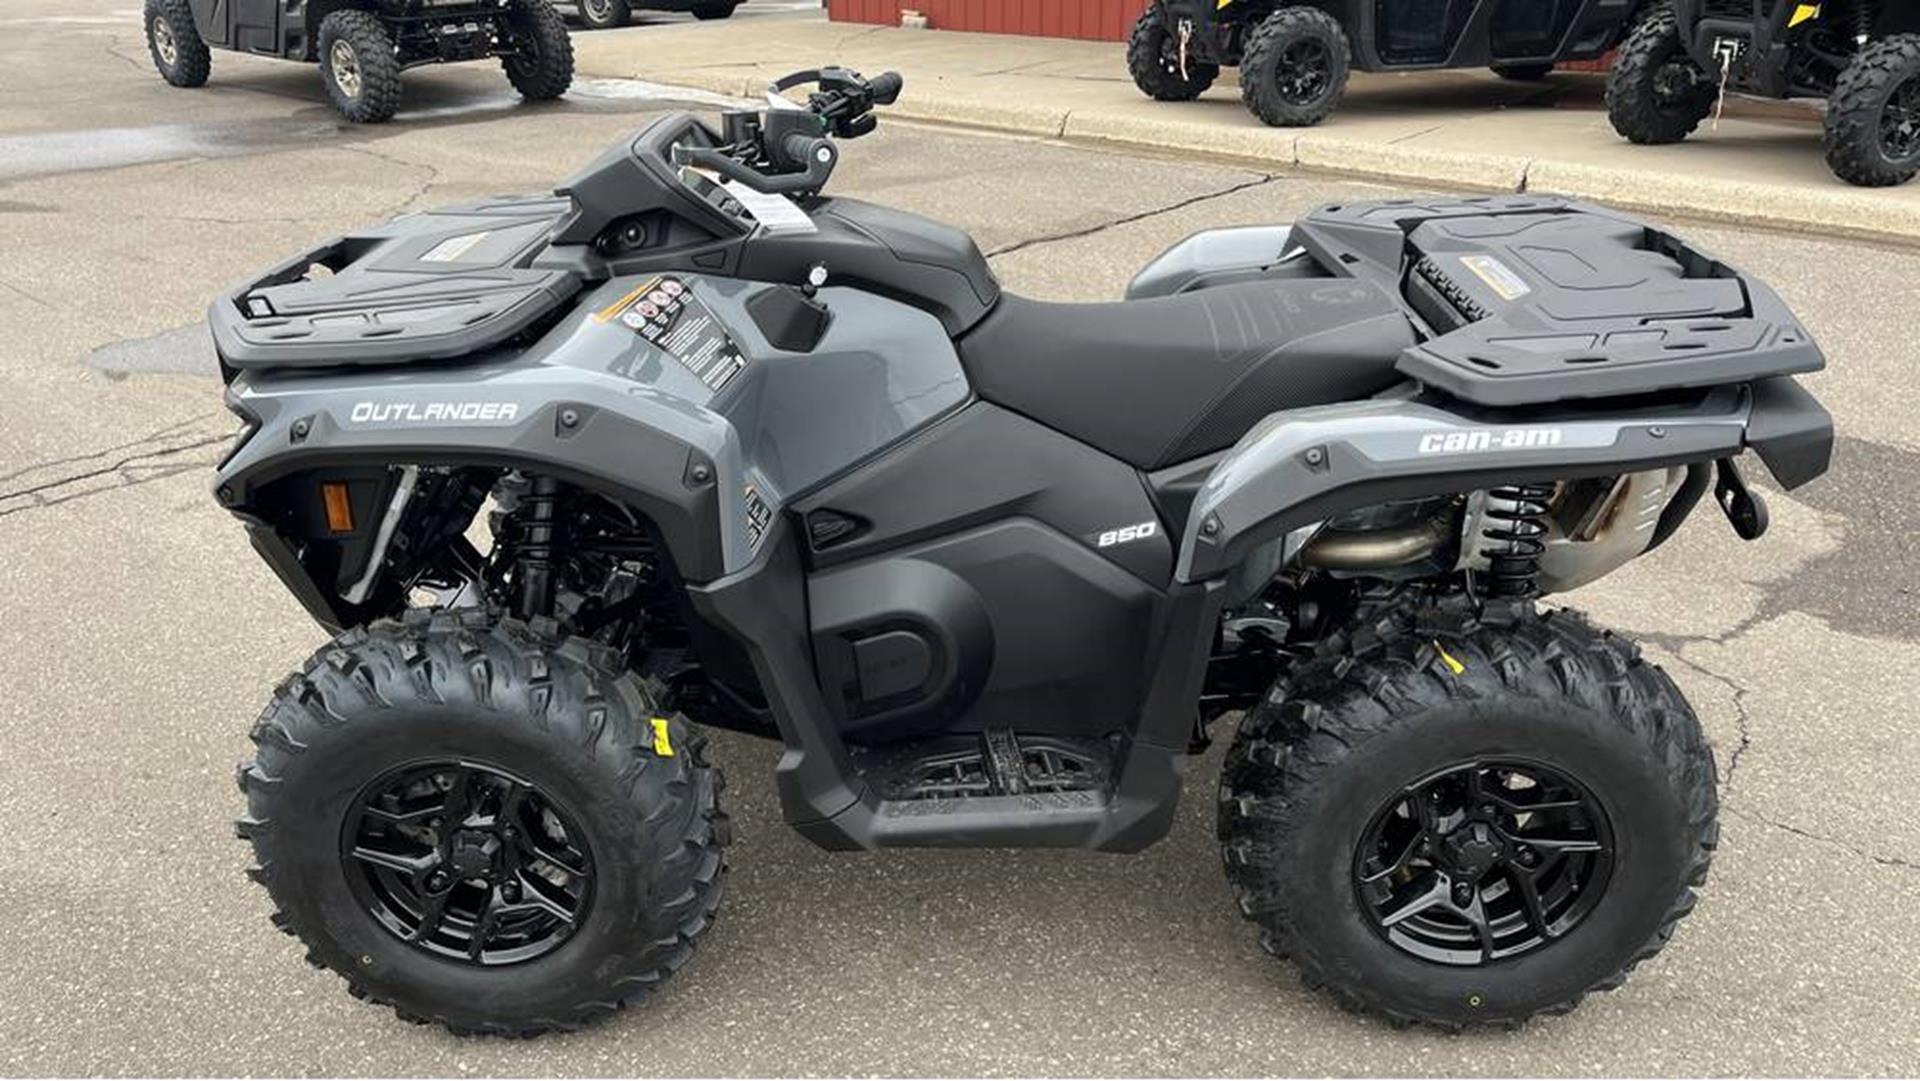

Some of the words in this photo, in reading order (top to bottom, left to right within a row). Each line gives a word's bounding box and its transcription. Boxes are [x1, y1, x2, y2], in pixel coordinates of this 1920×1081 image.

[351, 402, 519, 422] OUTLANDER
[1419, 428, 1562, 453] can-am
[1098, 521, 1156, 547] 850
